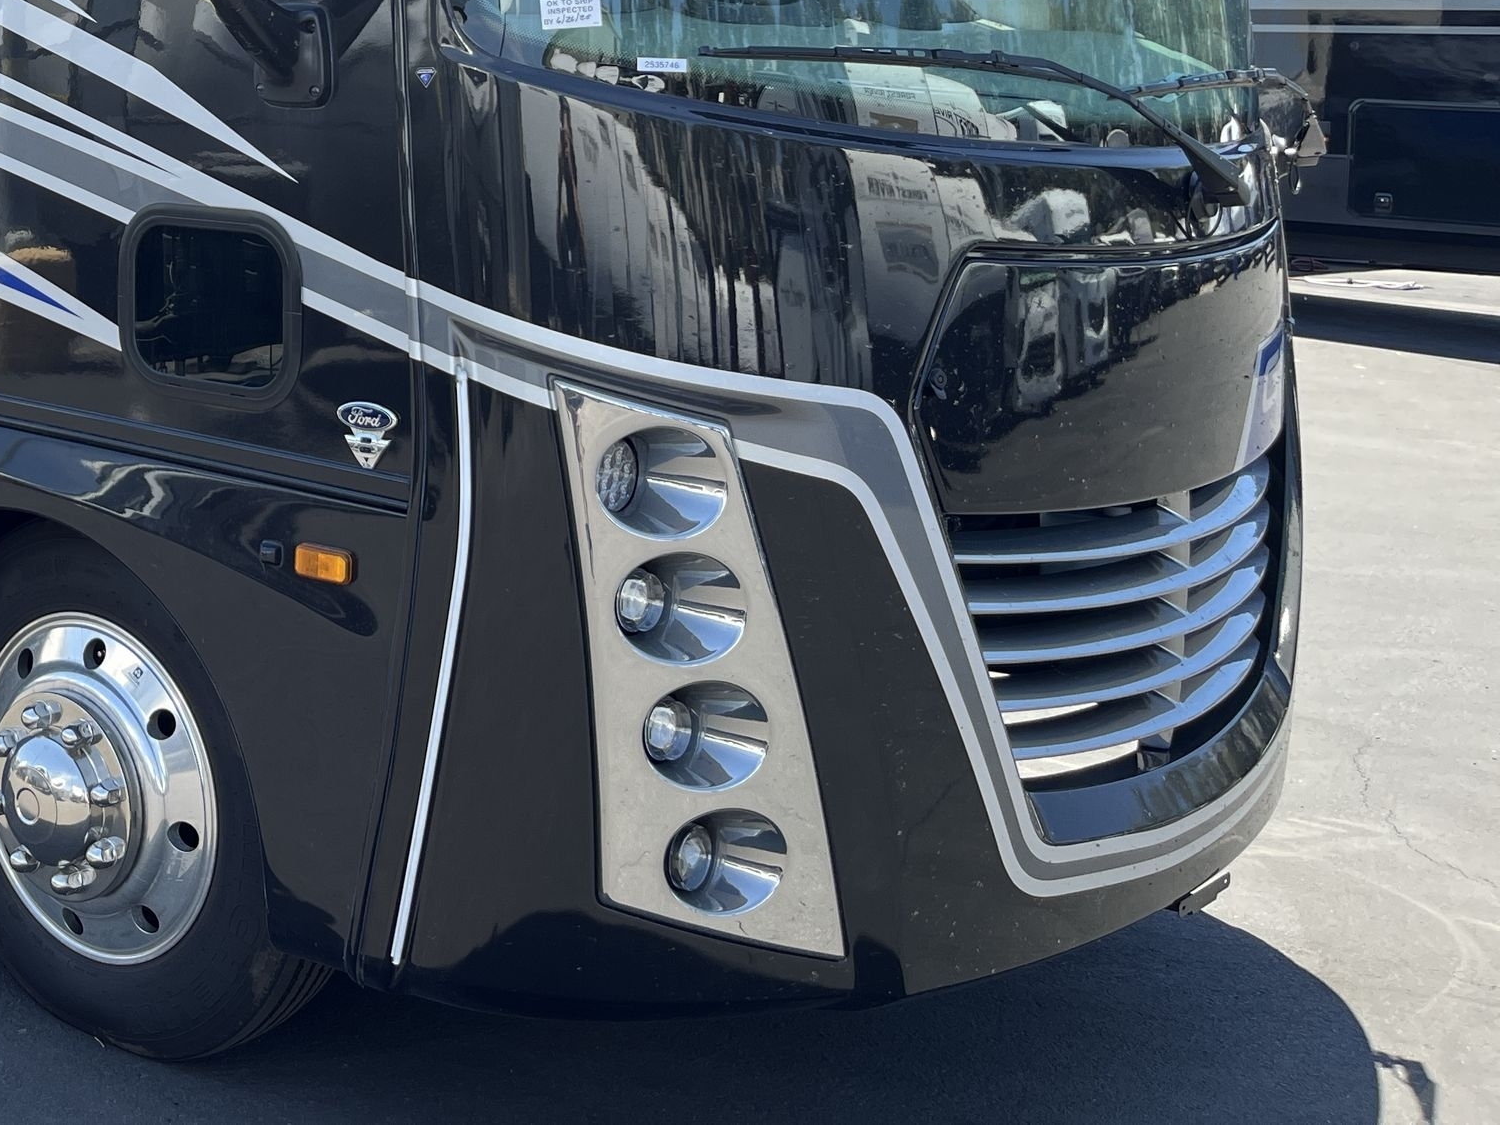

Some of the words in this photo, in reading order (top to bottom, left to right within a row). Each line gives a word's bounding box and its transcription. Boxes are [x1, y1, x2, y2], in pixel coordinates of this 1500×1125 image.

[546, 0, 559, 8] OK
[547, 5, 594, 15] INSPECTED
[347, 406, 382, 428] Ford
